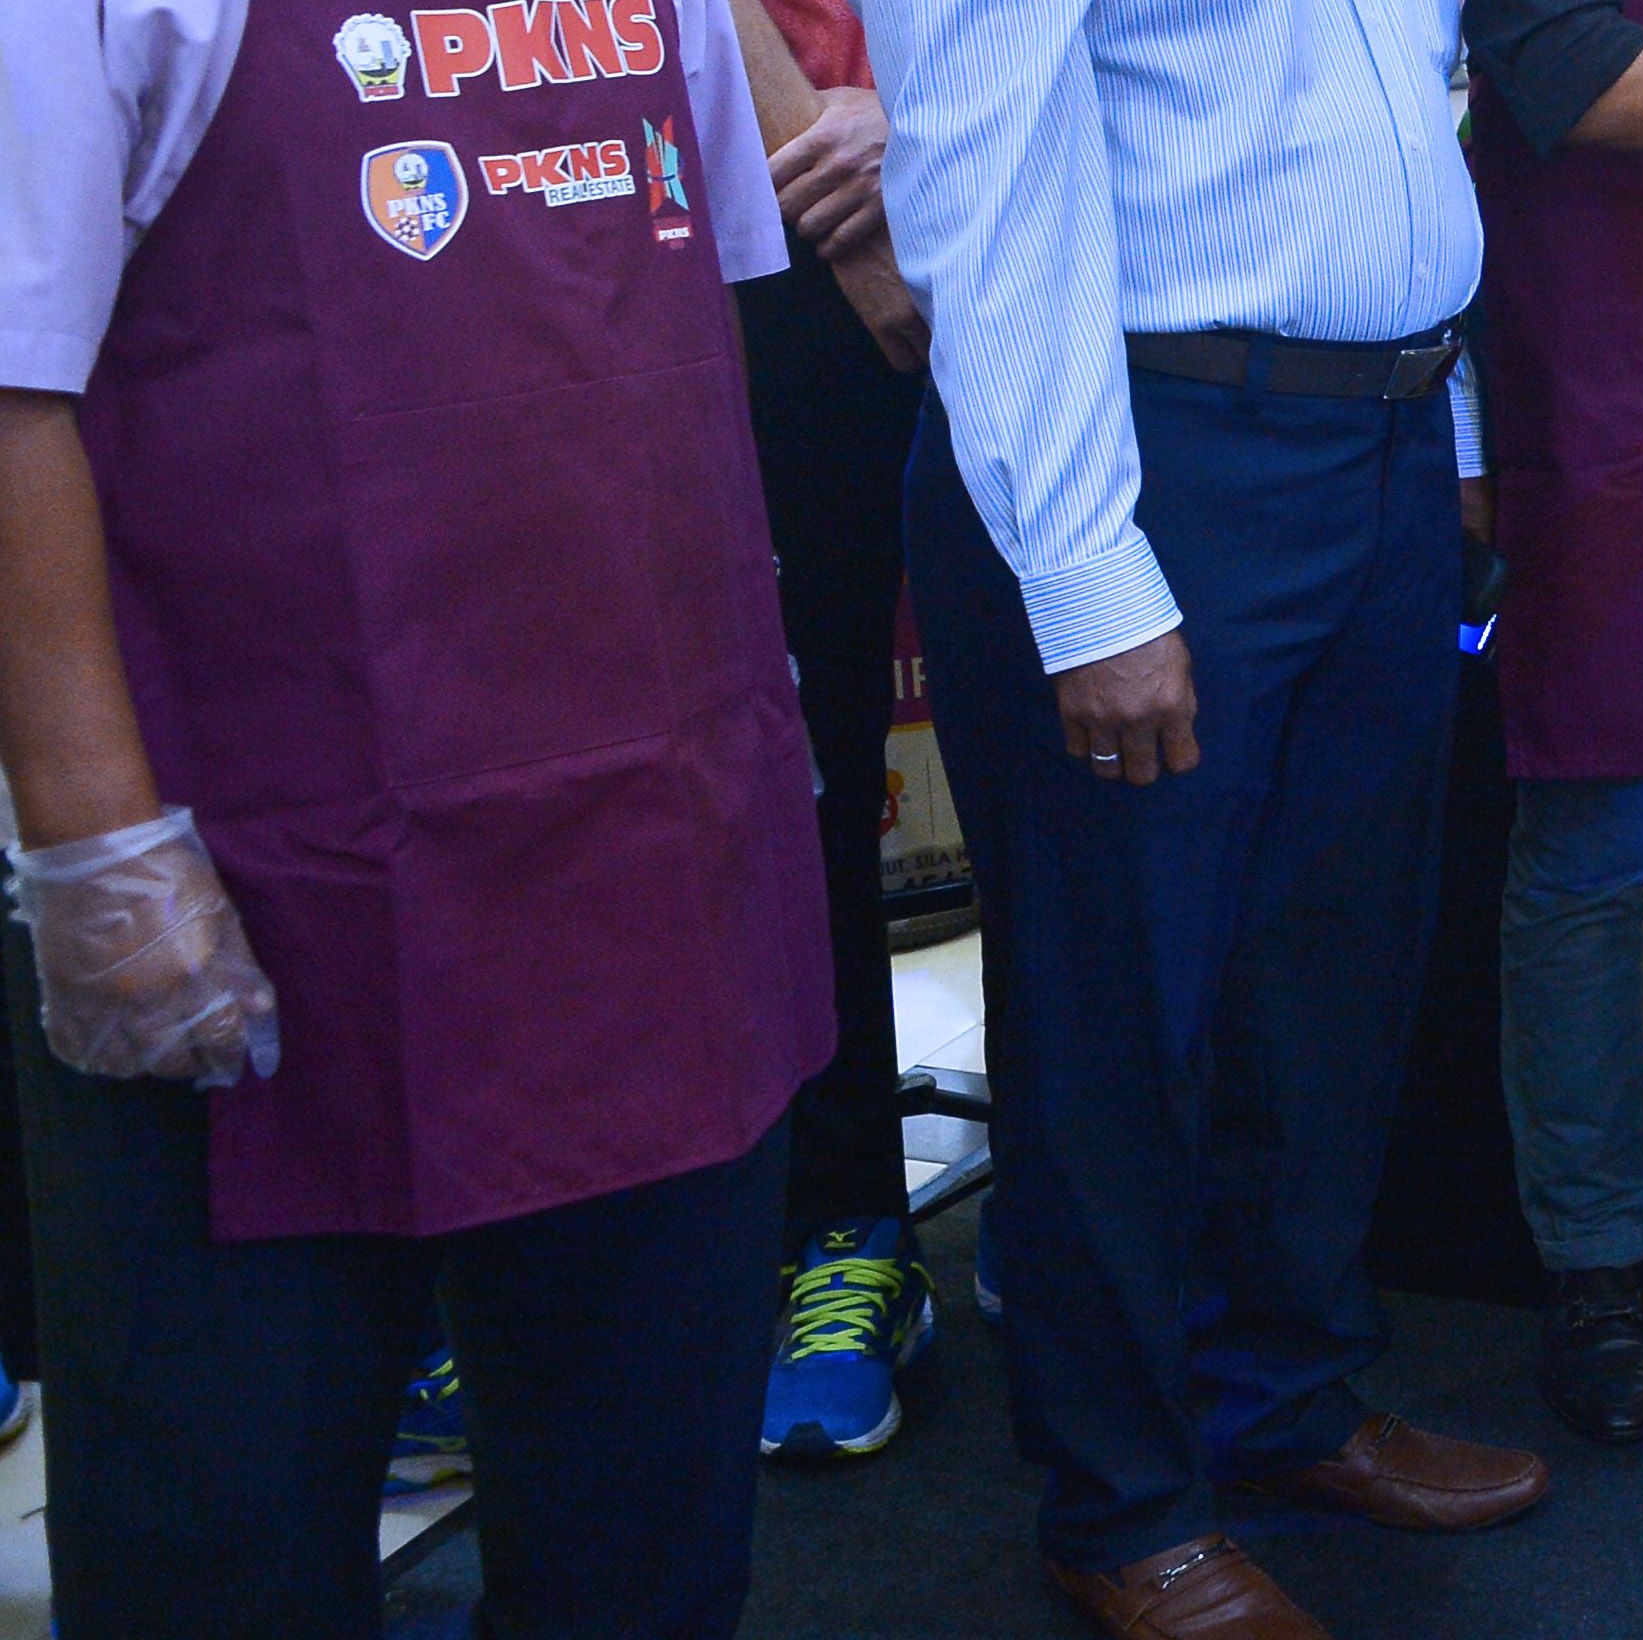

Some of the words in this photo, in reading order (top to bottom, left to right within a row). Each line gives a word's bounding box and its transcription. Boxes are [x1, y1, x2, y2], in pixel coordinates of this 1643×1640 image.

[478, 140, 629, 195] PKNS
[549, 186, 586, 205] REAL
[586, 179, 634, 198] ESTATE
[387, 194, 446, 218] PKNS
[422, 211, 450, 231] FC
